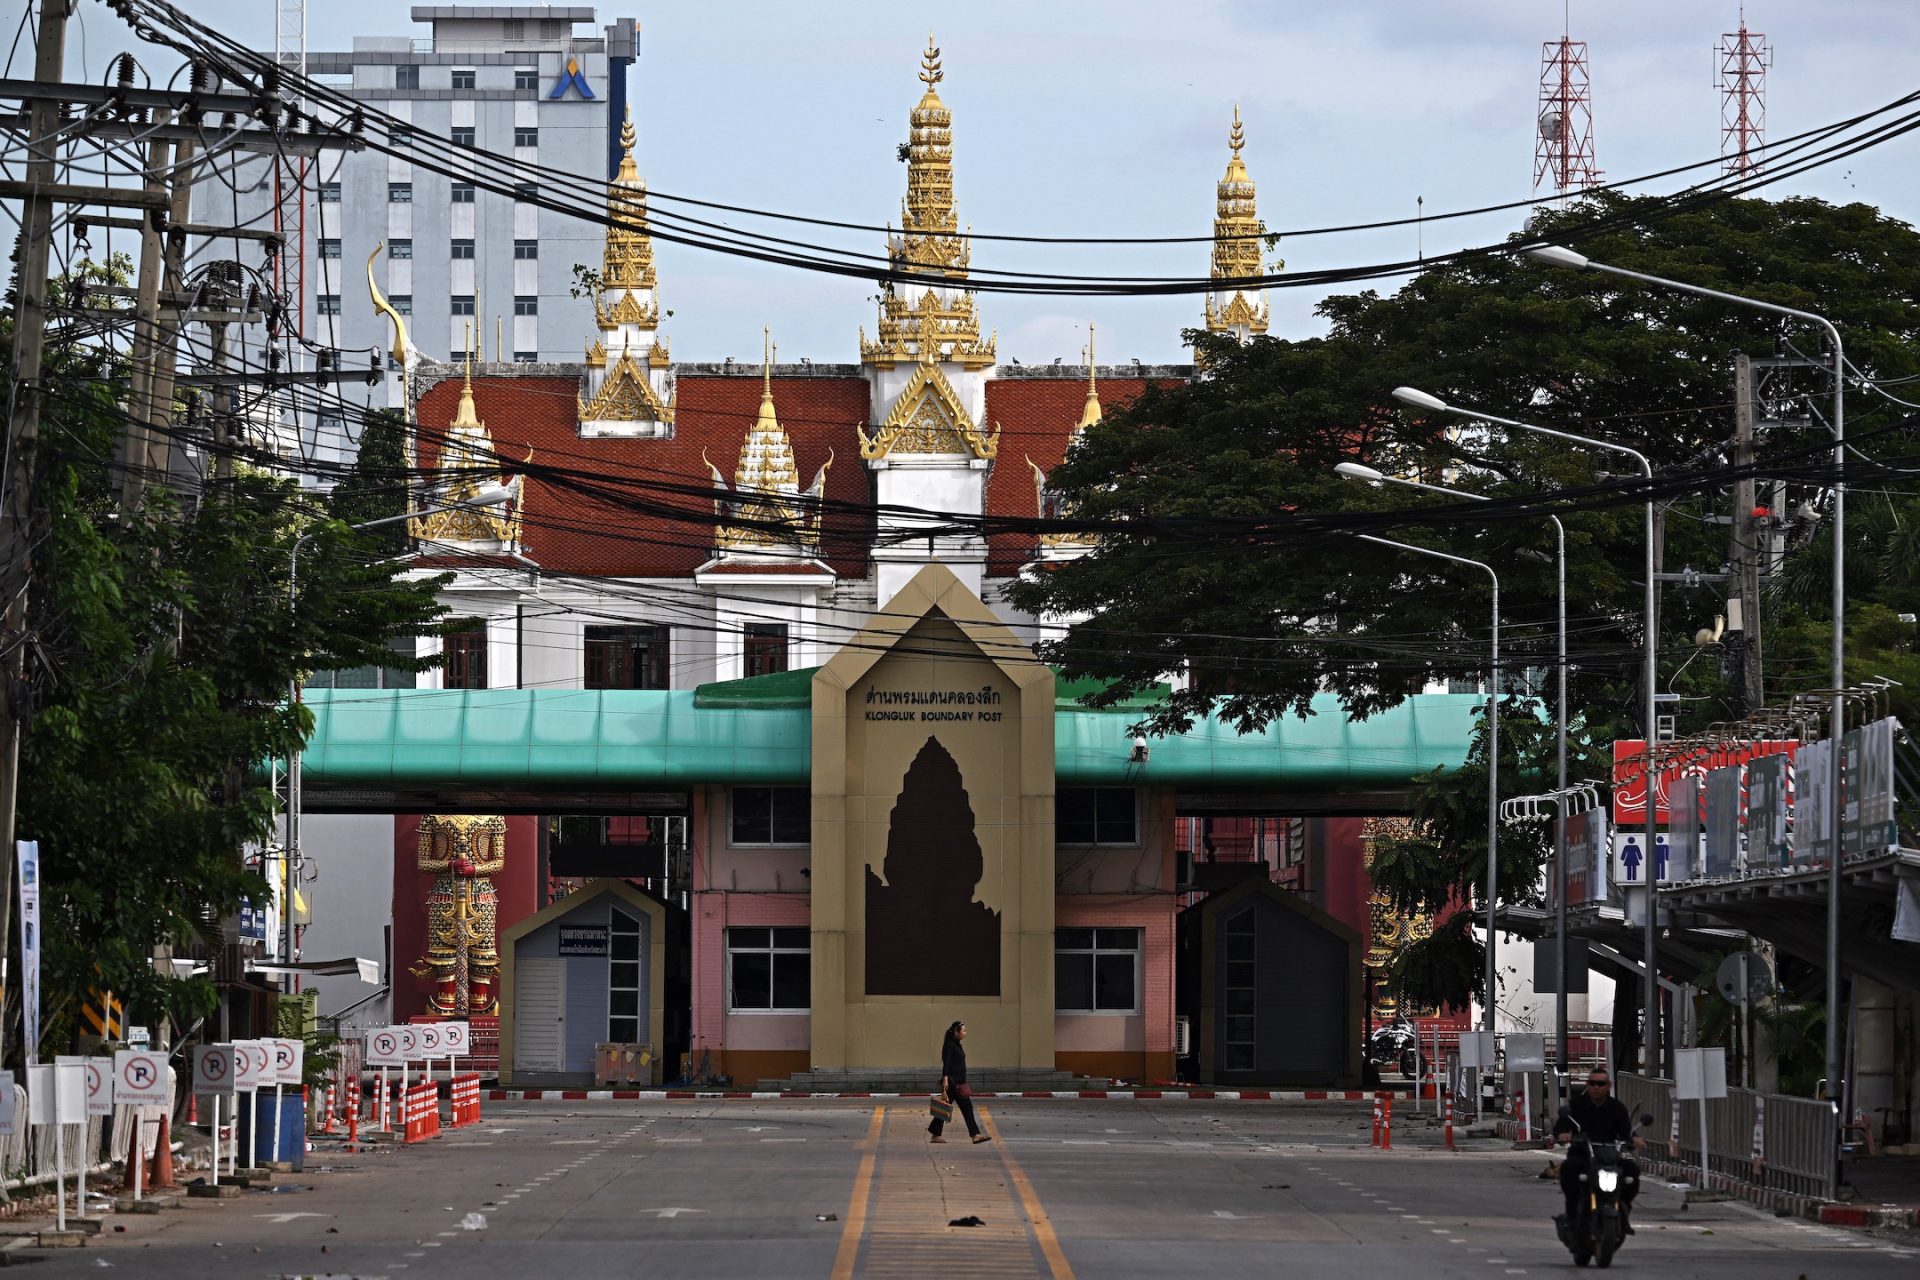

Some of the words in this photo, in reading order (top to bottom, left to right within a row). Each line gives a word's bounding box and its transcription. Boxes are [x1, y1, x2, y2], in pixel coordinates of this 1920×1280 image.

[866, 685, 1001, 705] ด่านพรมแดนคลองลึก
[865, 711, 916, 722] KLONGLUK
[921, 711, 974, 722] BOUNDARY
[978, 711, 1002, 722] POST
